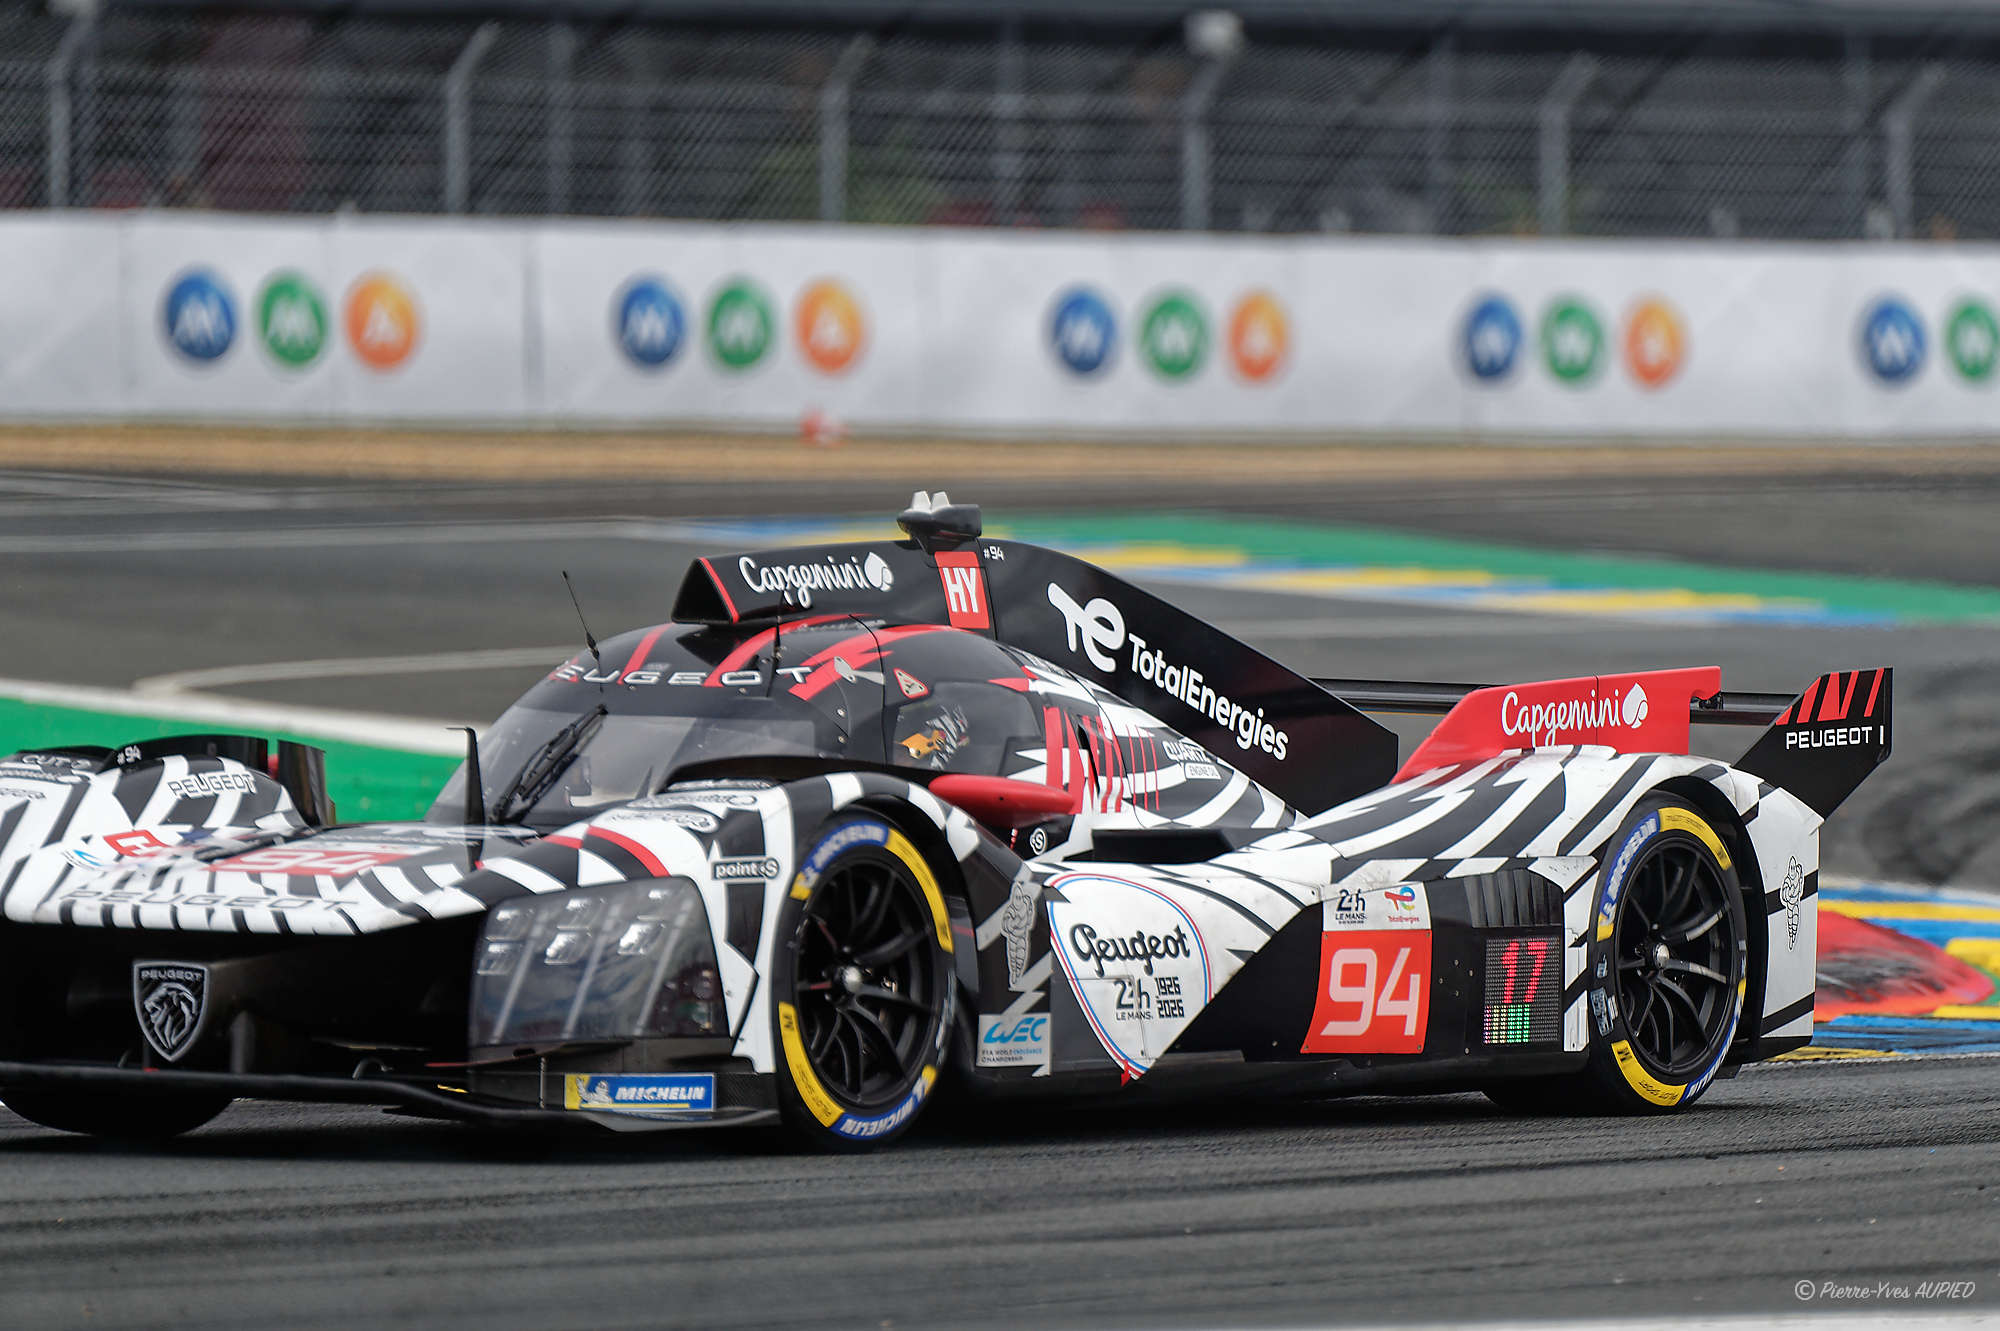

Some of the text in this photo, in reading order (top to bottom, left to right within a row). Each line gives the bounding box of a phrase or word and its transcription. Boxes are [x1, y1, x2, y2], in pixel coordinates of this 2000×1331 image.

[983, 546, 1004, 561] #94
[738, 555, 871, 609] Capgemini
[942, 567, 979, 614] HY
[556, 661, 813, 687] EUGEOT
[1128, 632, 1289, 761] TotalEnergies
[1501, 688, 1622, 748] Capgemini
[1785, 726, 1873, 750] PEUGEOT
[117, 745, 142, 765] #94
[167, 773, 257, 797] PEUGEOT
[715, 862, 759, 879] point
[59, 889, 360, 909] PEUGEOT
[1344, 912, 1366, 920] MANS
[1069, 923, 1191, 978] Peugeot
[140, 969, 203, 981] PEUGEOT
[1501, 940, 1549, 1004] 17
[1154, 976, 1182, 996] 1926
[1320, 947, 1421, 1037] 94
[1115, 1011, 1152, 1021] LE MANS
[1155, 998, 1185, 1018] 2026
[983, 1017, 1047, 1044] WEC
[614, 1086, 706, 1101] MICHELIN
[840, 1097, 915, 1137] MICHELIN
